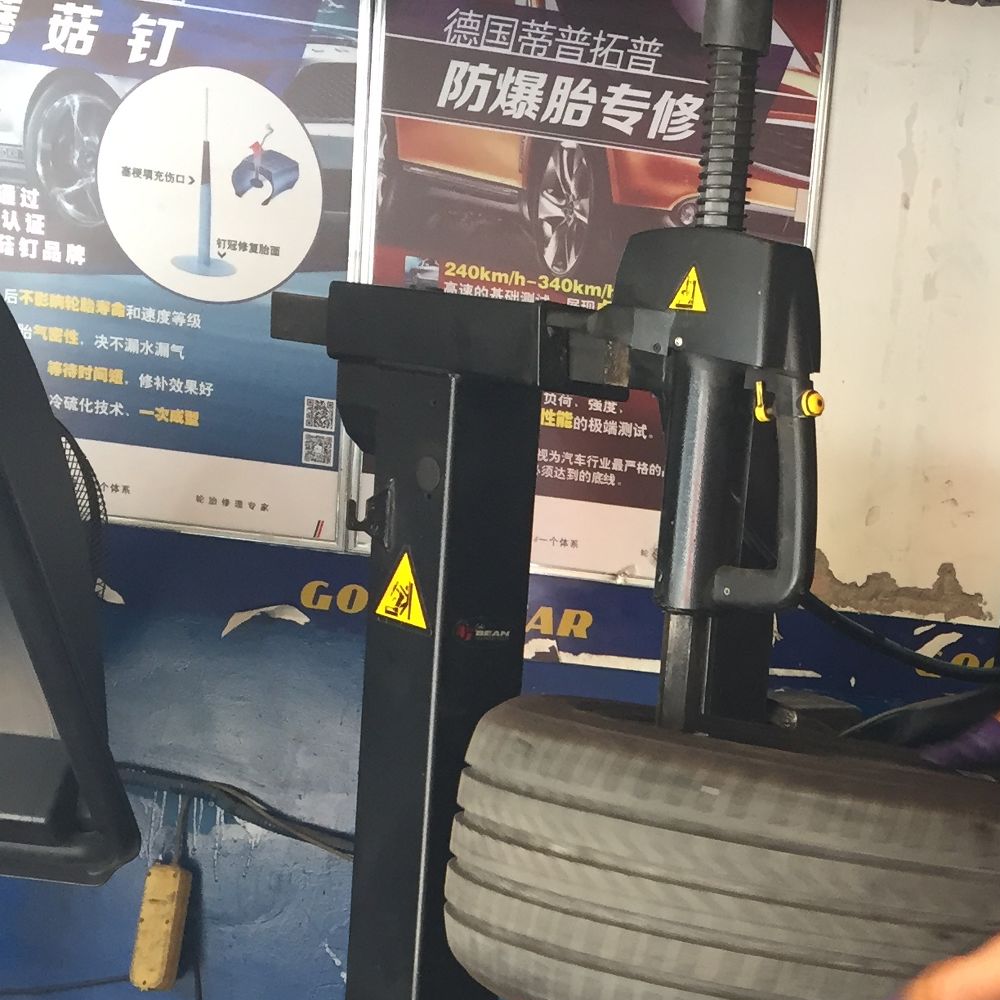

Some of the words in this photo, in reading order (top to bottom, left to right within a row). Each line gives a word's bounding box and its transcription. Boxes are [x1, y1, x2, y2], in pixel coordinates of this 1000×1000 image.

[443, 7, 664, 73] 德国蒂普拓普
[435, 60, 705, 142] 防爆胎专修
[1, 209, 45, 235] 认证
[537, 448, 665, 477] 视为汽车行业最严格的
[300, 580, 369, 614] GO
[524, 605, 593, 640] AR
